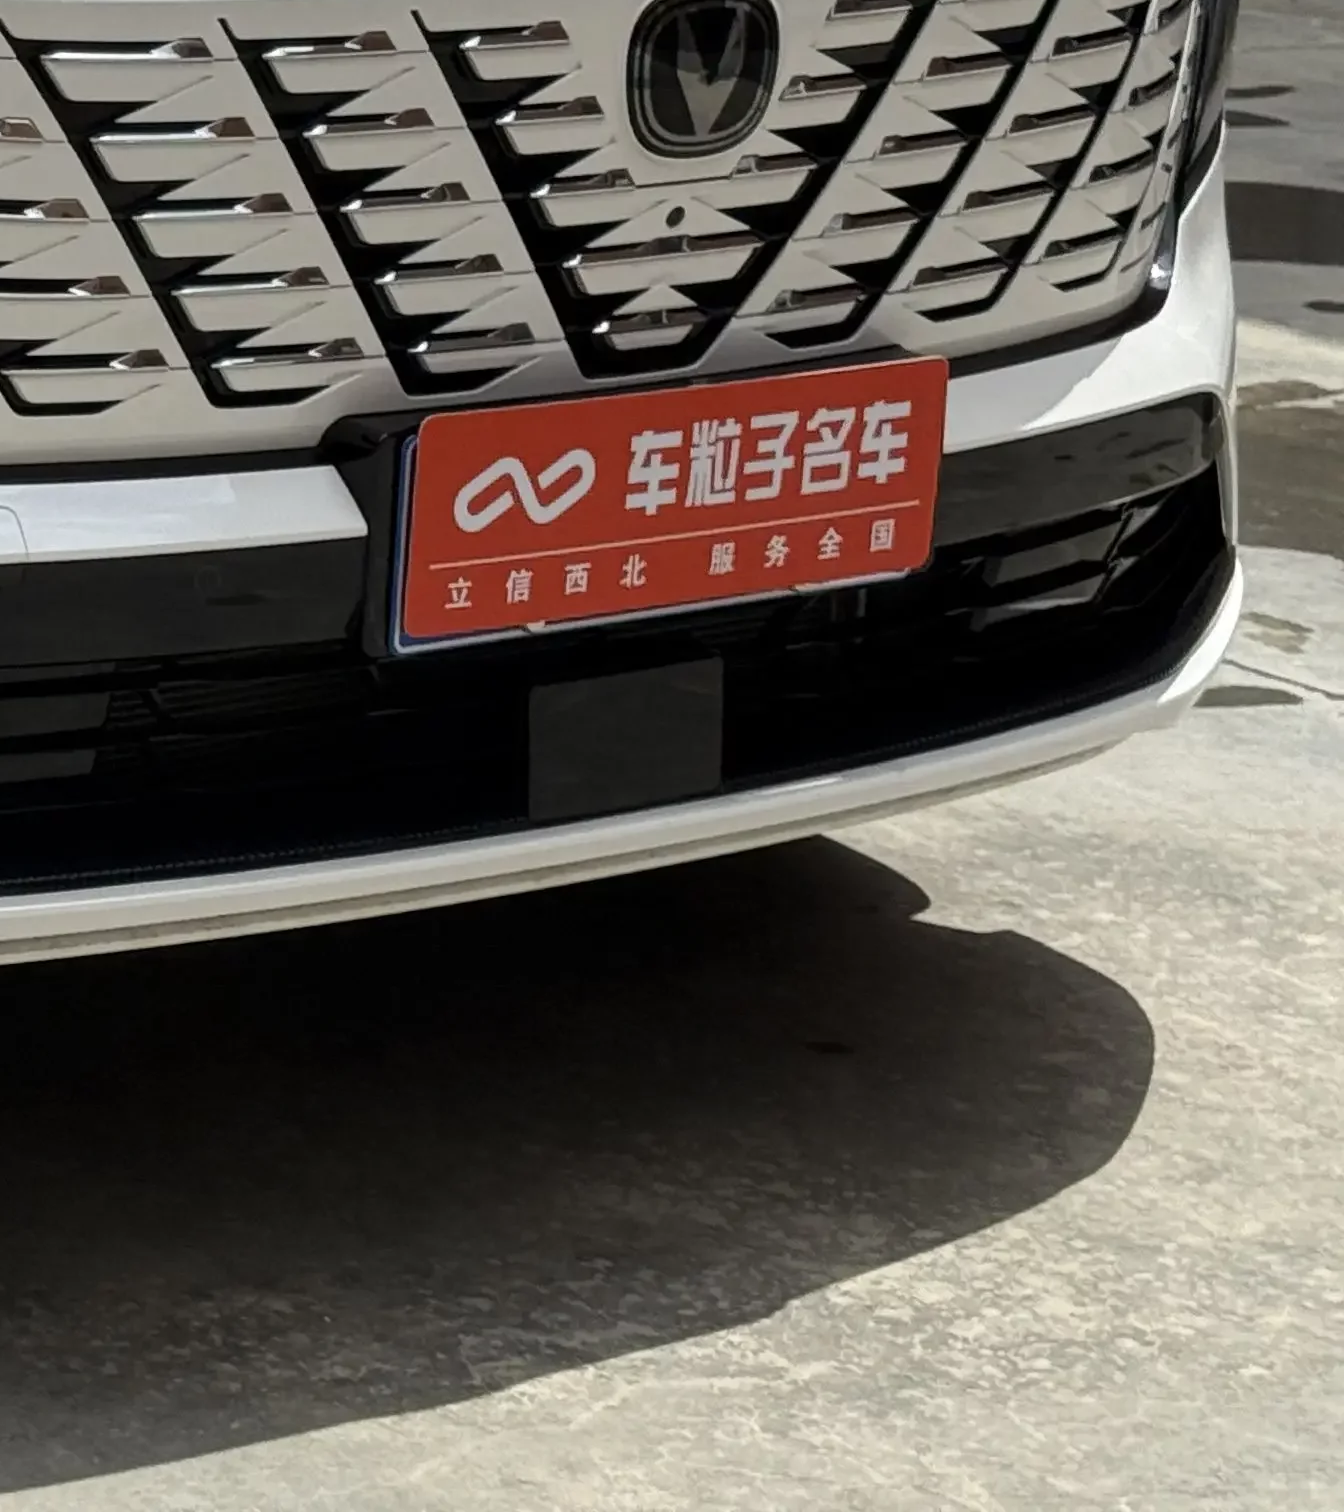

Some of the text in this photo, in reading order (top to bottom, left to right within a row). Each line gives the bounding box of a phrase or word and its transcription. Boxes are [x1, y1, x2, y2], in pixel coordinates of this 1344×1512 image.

[625, 399, 912, 516] 车粒子名车
[444, 518, 896, 610] 立信西北 服务全国
